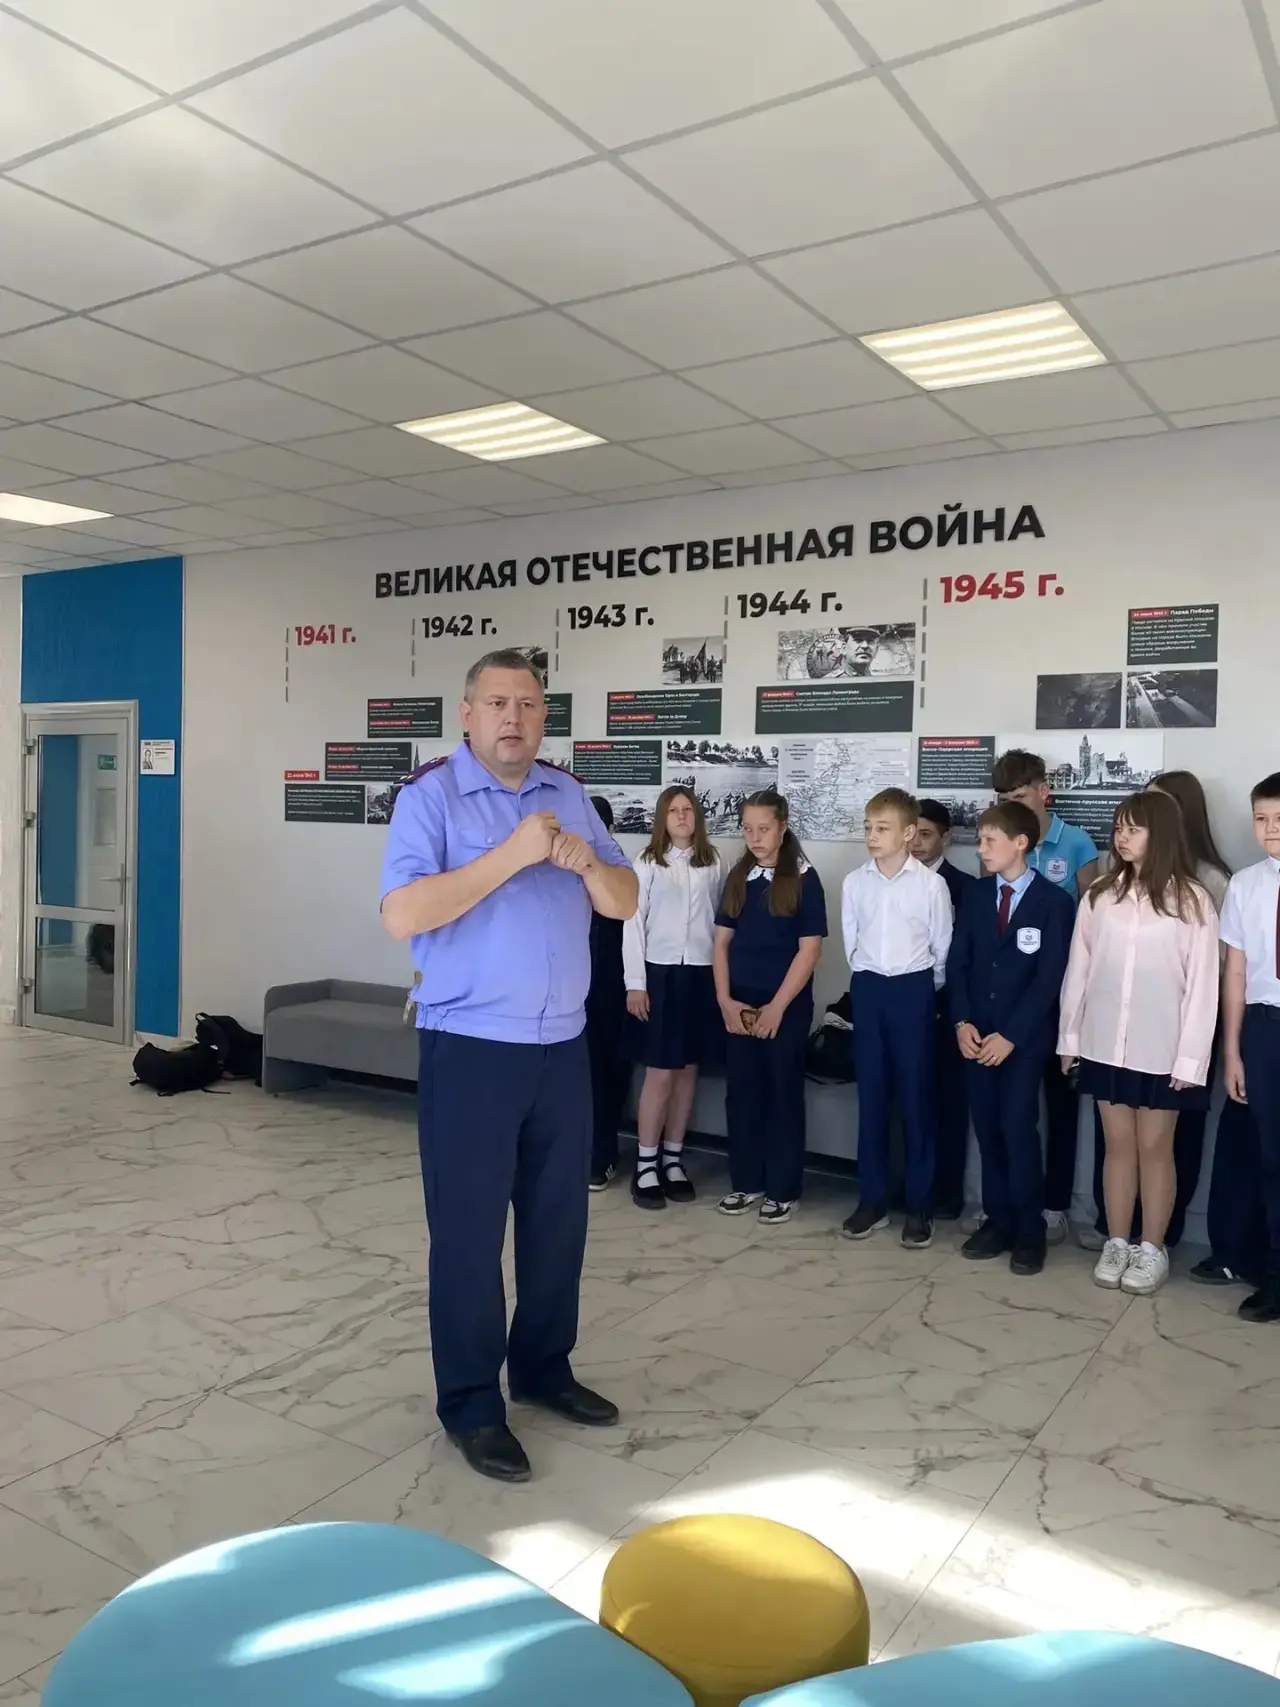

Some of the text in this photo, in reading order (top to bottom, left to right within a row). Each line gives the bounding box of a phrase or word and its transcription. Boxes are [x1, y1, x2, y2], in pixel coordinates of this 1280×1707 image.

[375, 502, 1046, 598] ВЕЛИКАЯ ОТЕЧЕСТВЕННАЯ ВОЙНА
[939, 570, 1065, 604] 1945 г.
[567, 603, 655, 630] 1943 г.
[737, 588, 843, 619] 1944 г.
[295, 624, 357, 646] 1941 г.
[421, 614, 498, 638] 1942 г.
